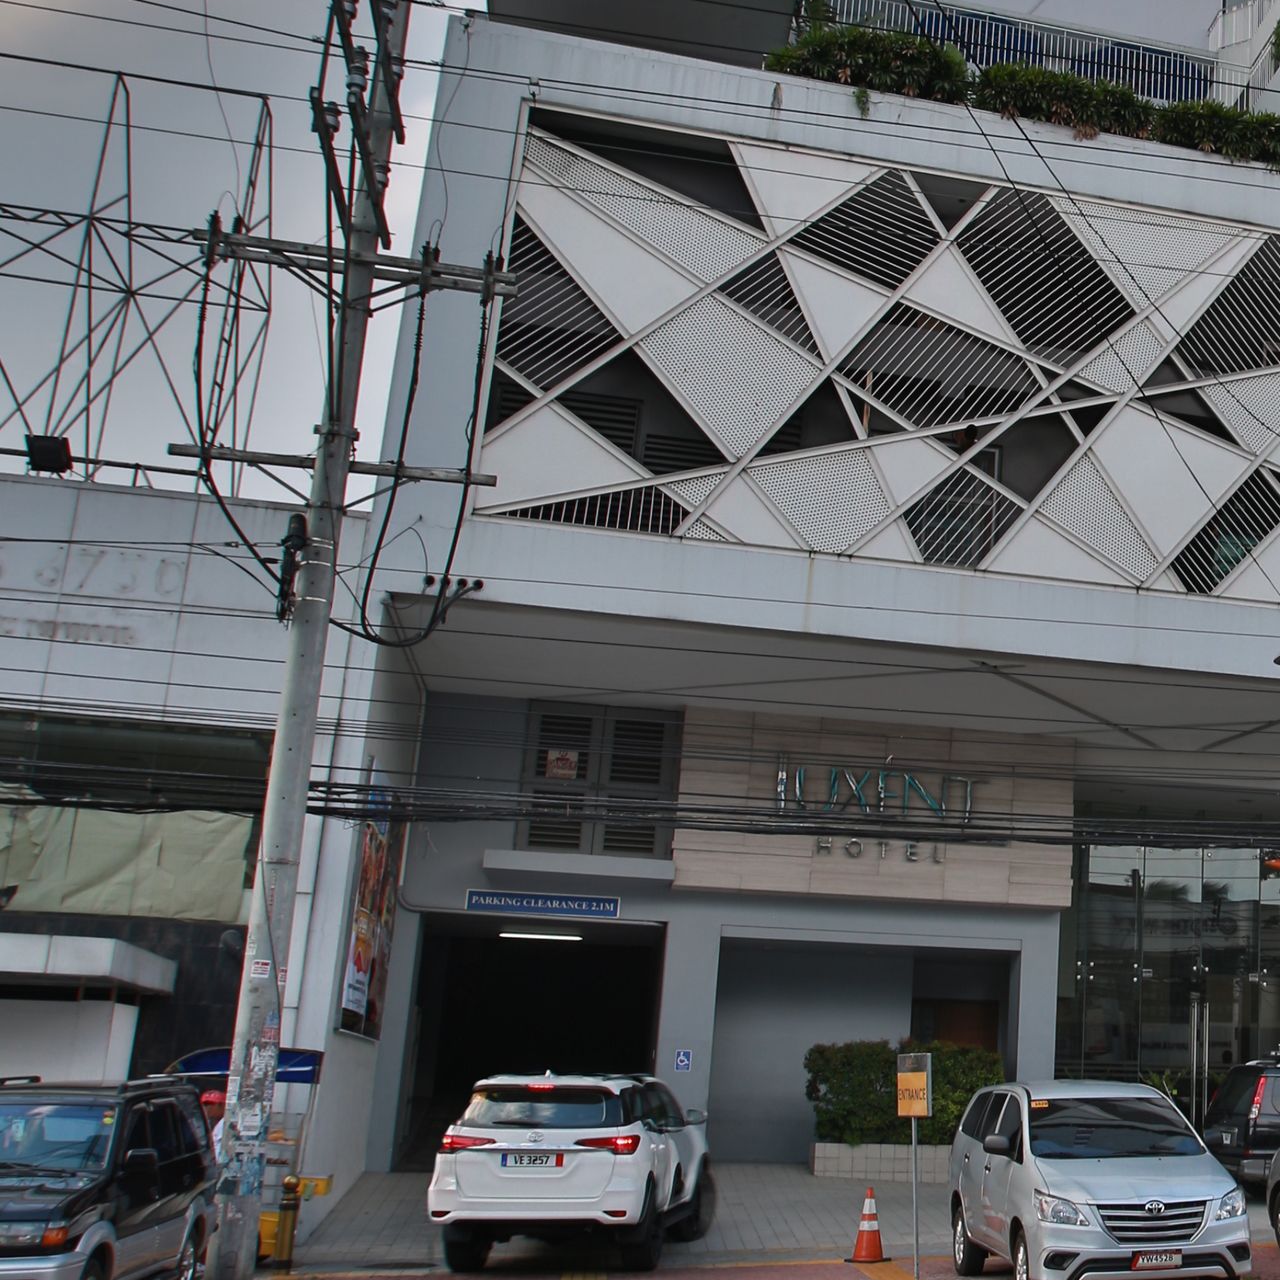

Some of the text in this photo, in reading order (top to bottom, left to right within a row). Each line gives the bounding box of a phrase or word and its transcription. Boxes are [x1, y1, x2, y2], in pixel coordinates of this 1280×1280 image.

[816, 836, 945, 864] HOTEL
[471, 895, 614, 912] PARKING CLEARANCE 2.1M
[898, 1088, 926, 1101] ENTRANCE
